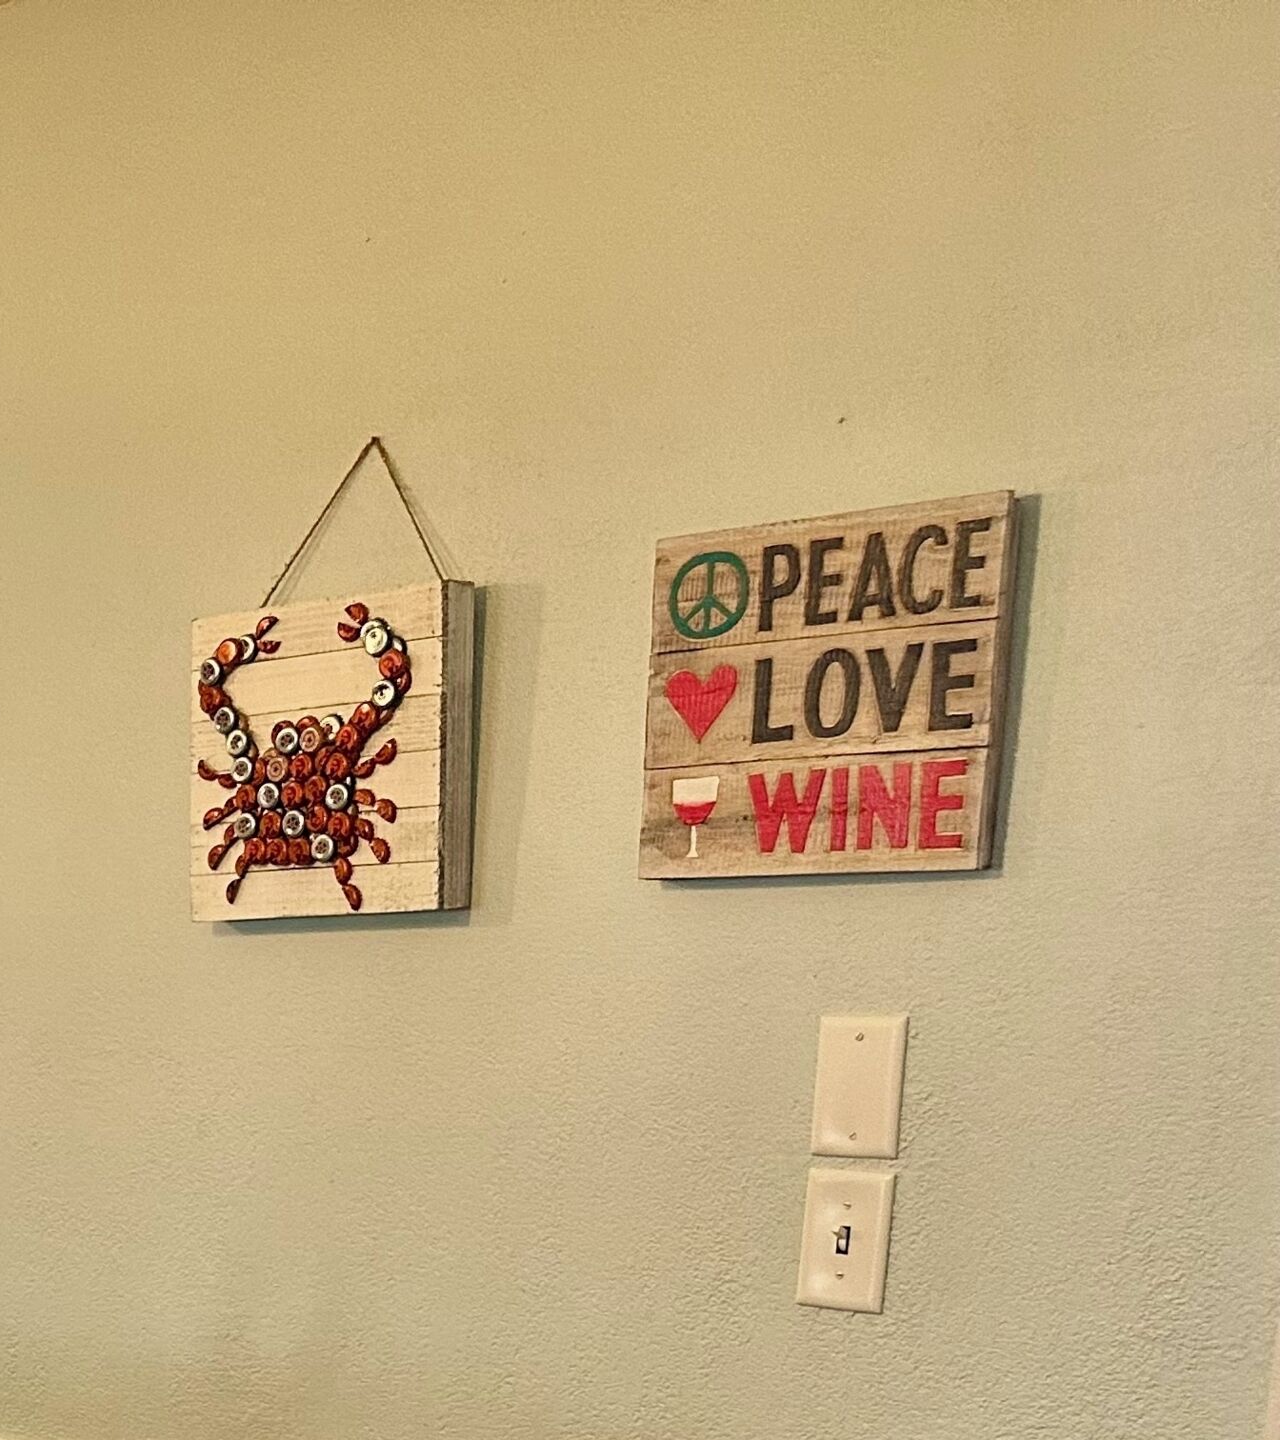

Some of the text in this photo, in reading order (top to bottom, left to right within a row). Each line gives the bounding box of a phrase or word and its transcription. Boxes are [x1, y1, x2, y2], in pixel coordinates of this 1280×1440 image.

[757, 516, 993, 633] PEACE
[750, 638, 979, 745] LOVE
[746, 758, 970, 855] WINE
